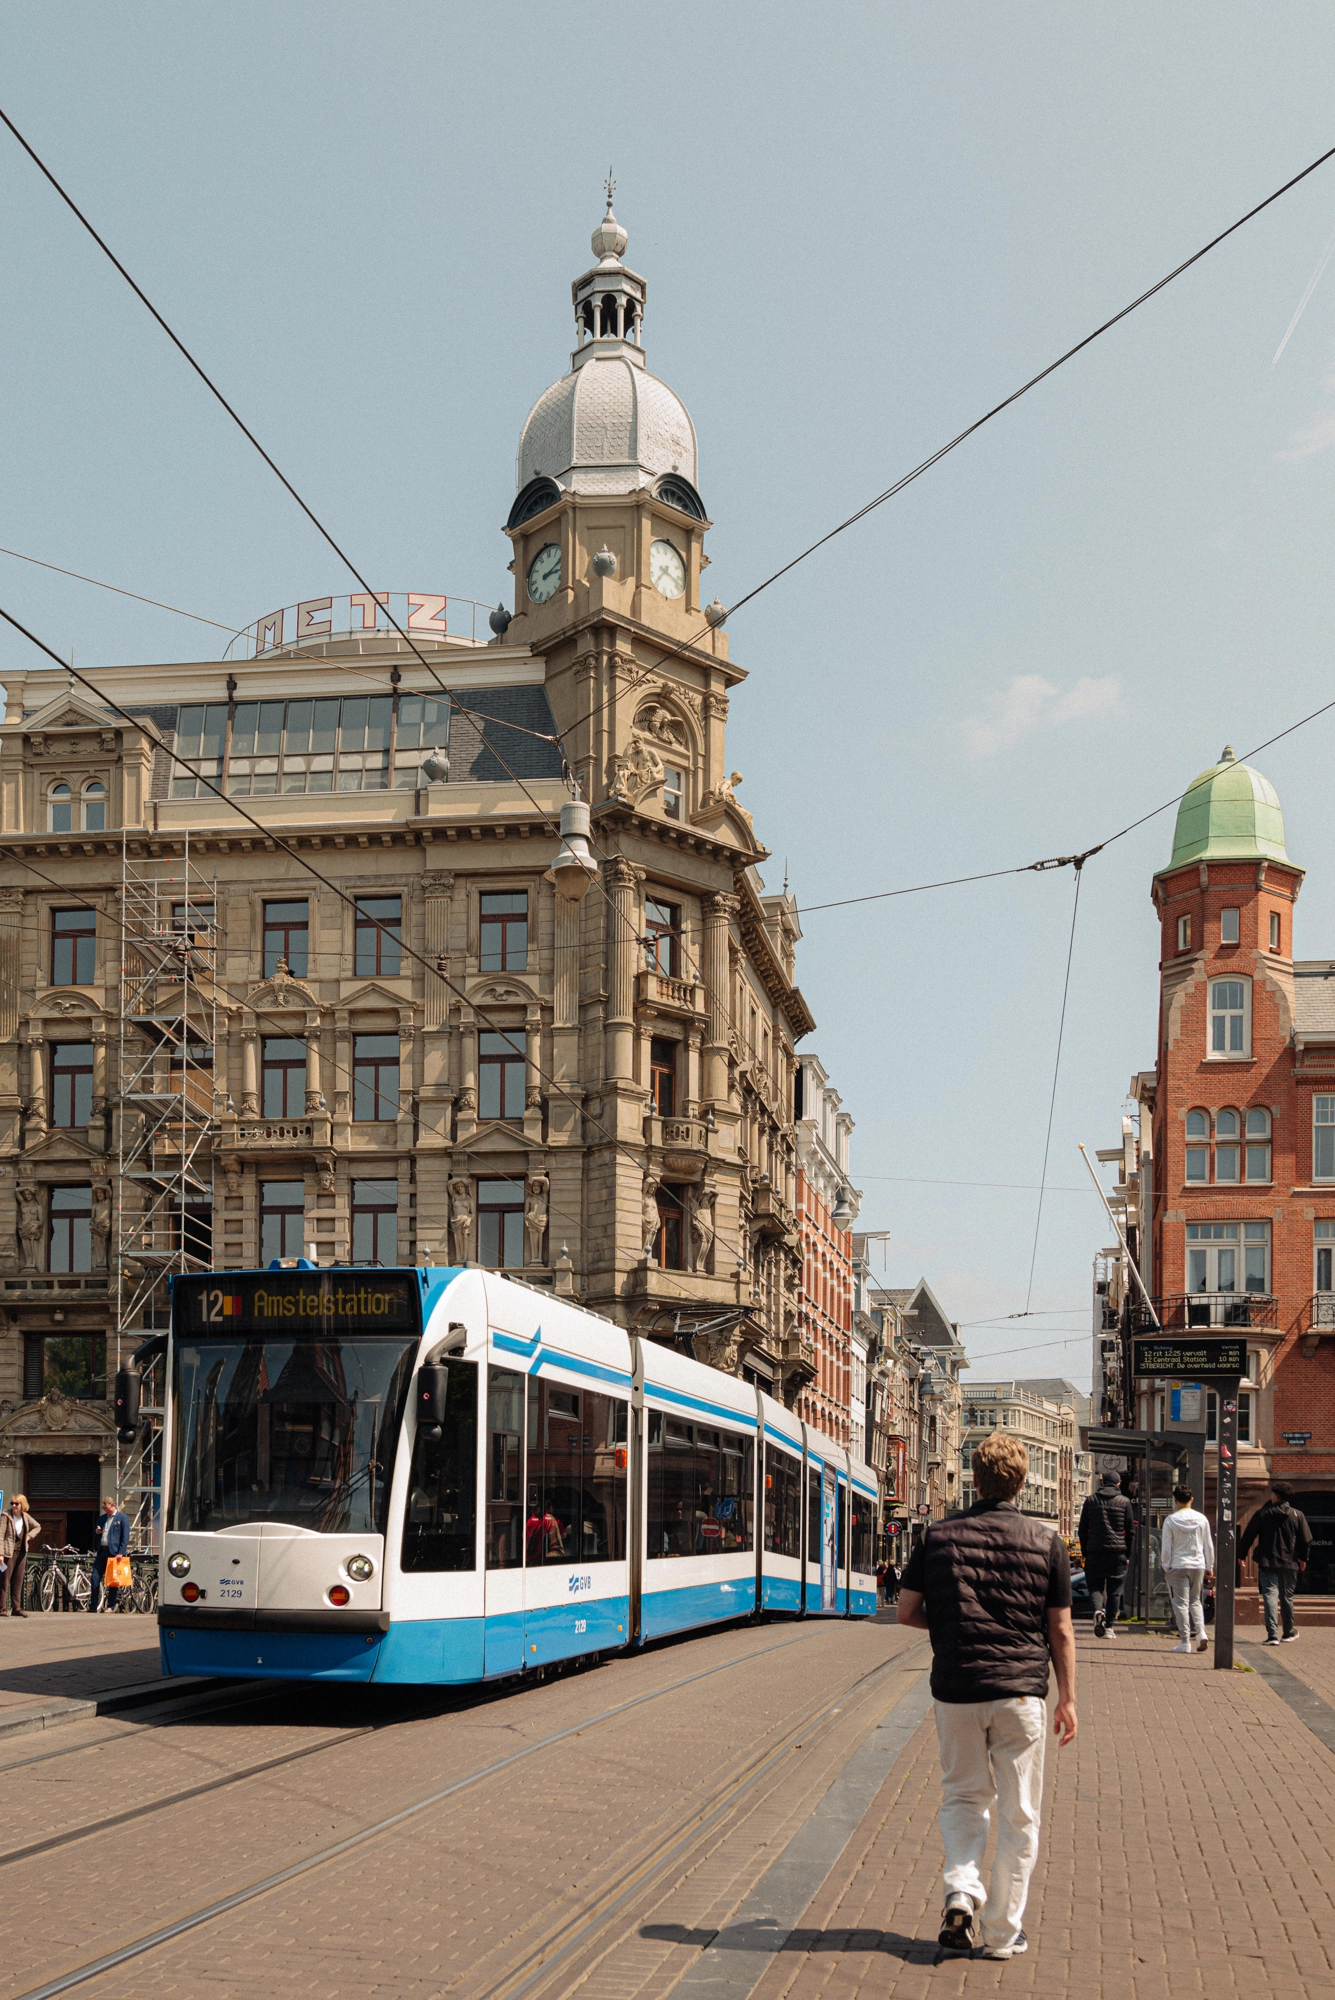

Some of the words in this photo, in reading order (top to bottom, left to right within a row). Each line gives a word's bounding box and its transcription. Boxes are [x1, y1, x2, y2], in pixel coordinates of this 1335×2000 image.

[255, 591, 447, 654] METZ
[198, 1290, 224, 1322] 12
[254, 1287, 397, 1316] Amstelstation
[220, 1590, 242, 1598] 2129
[580, 1576, 591, 1589] GVB
